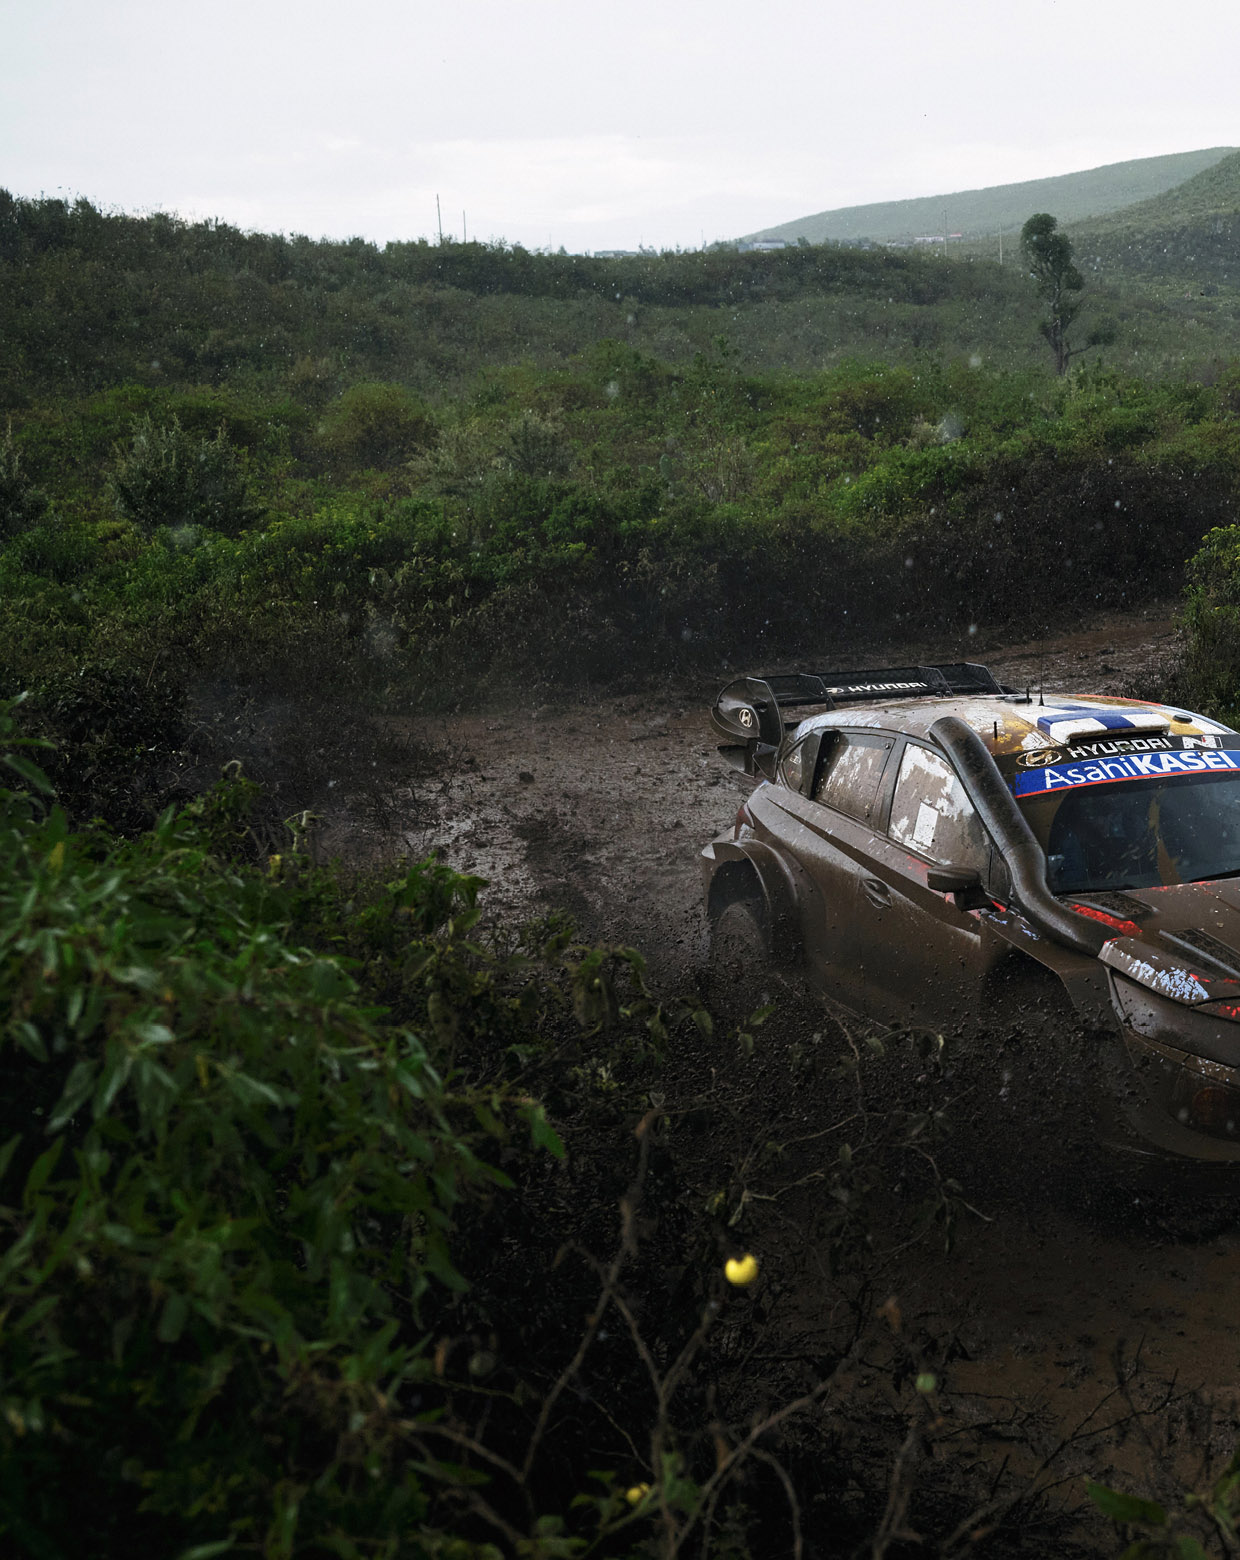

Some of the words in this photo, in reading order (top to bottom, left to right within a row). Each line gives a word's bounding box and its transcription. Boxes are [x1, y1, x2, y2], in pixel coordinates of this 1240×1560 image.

[848, 682, 927, 692] HYUNDAI
[1066, 736, 1173, 758] HYUNDAI
[1045, 750, 1238, 788] AsahiKASEI
